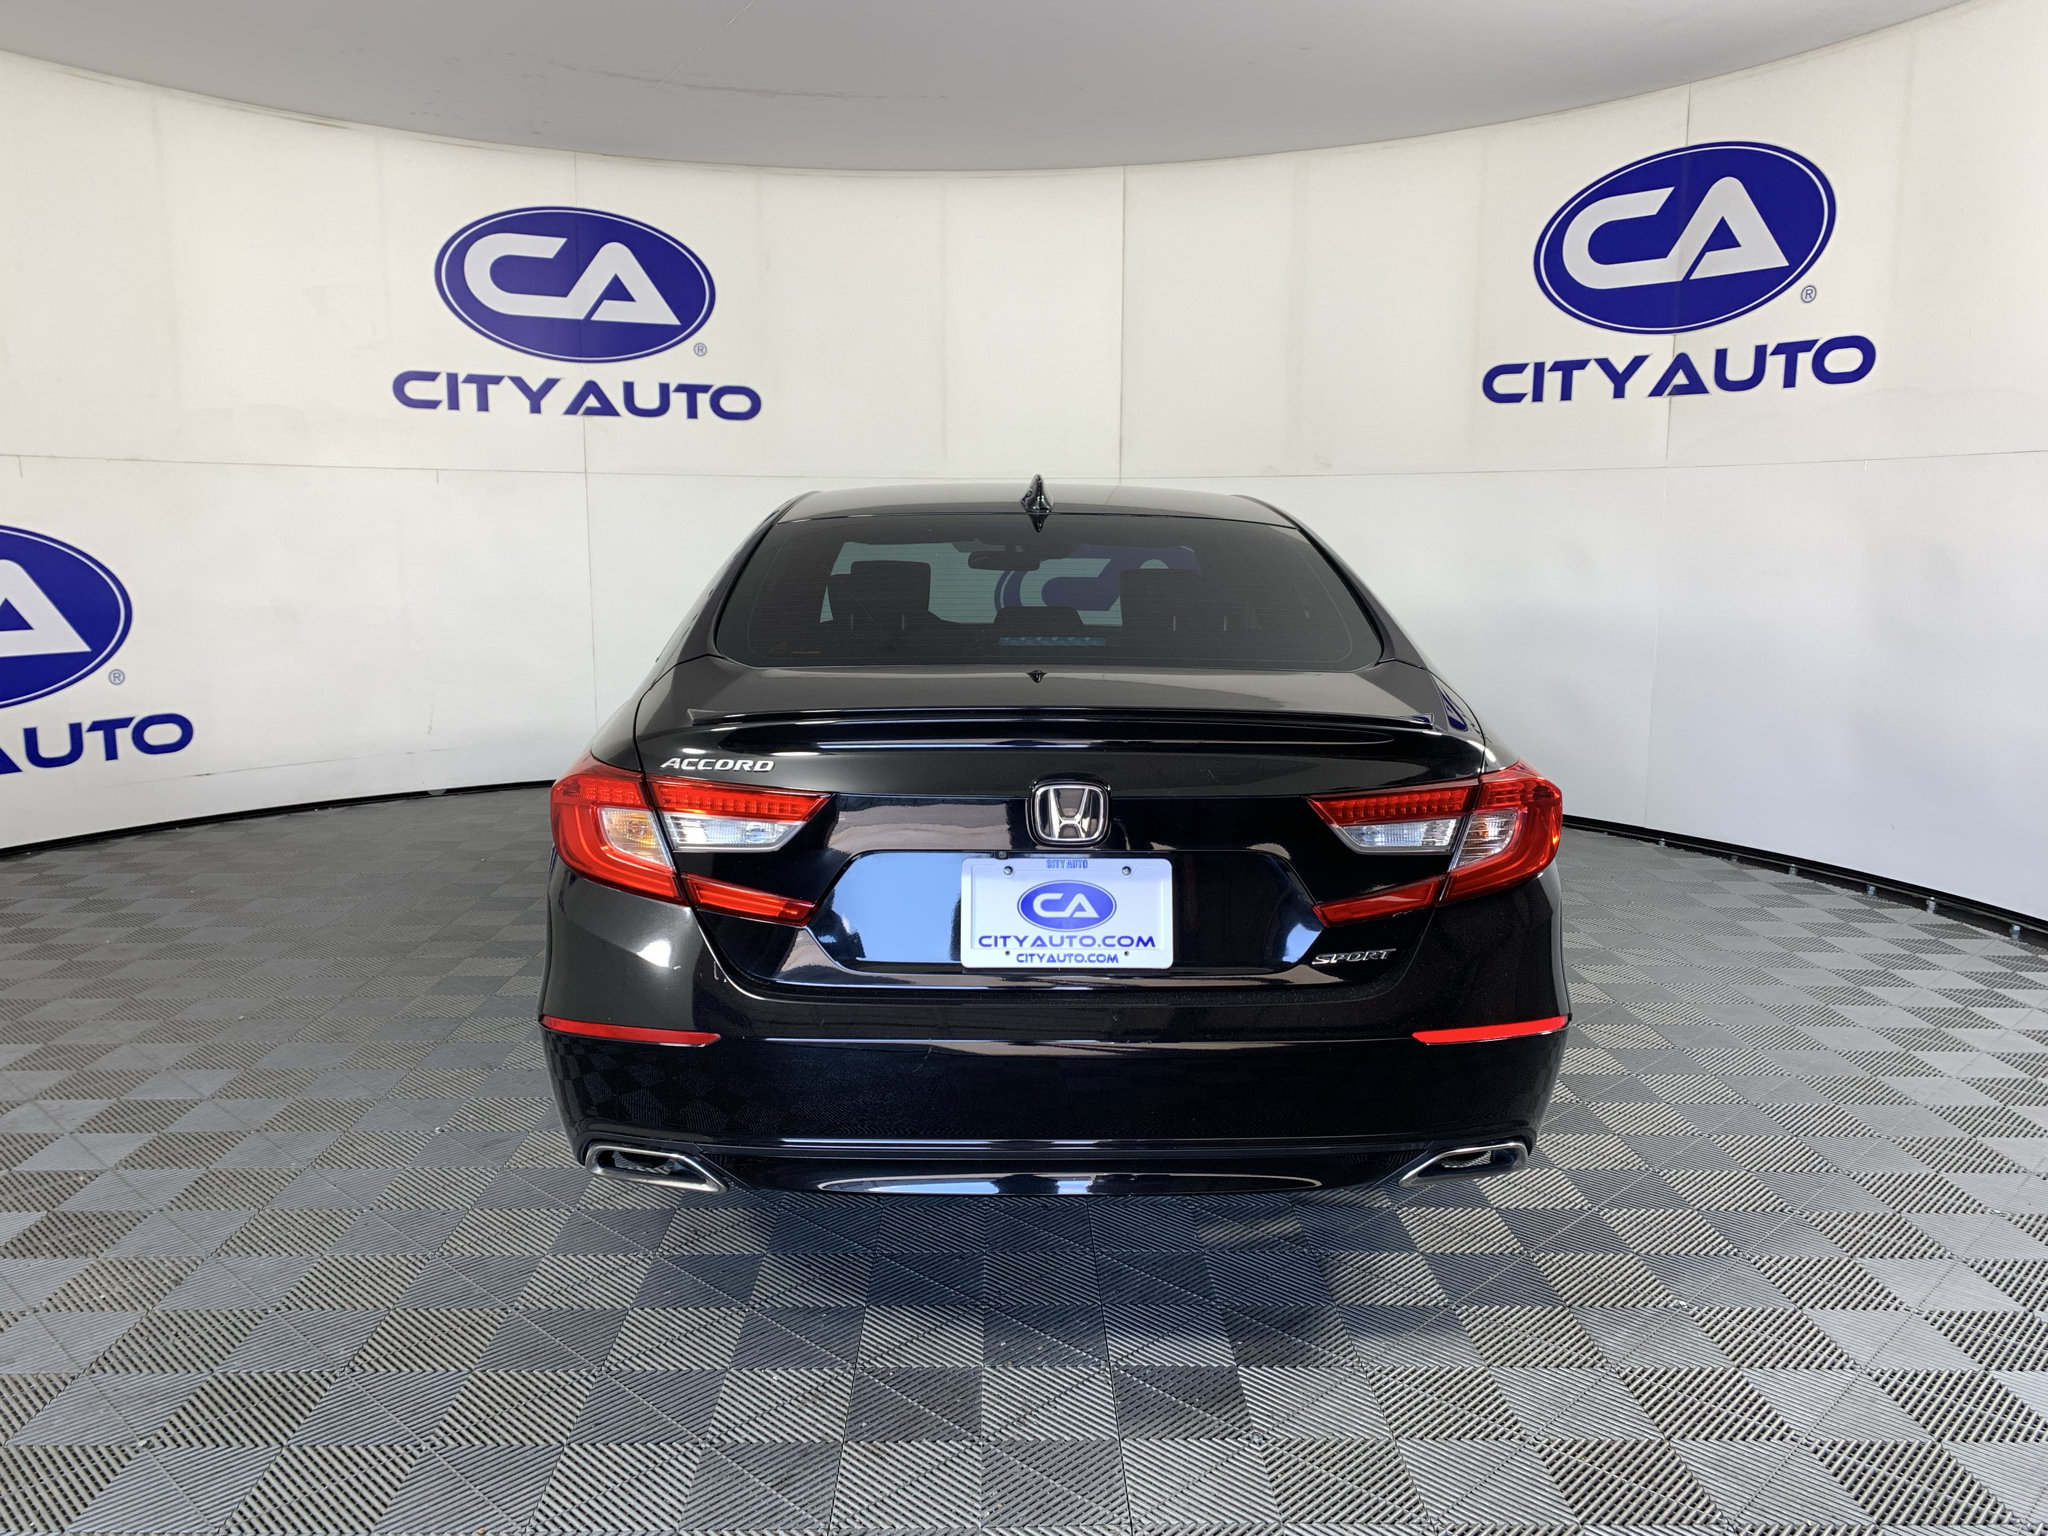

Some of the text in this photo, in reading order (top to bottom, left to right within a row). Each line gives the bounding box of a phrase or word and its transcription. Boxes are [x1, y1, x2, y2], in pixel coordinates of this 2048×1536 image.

[1562, 176, 1790, 290] CA
[464, 232, 682, 326] CA
[0, 559, 92, 658] A
[660, 757, 776, 772] ACCORD
[1046, 858, 1089, 869] CITY AUTO
[1032, 892, 1101, 919] CA
[978, 935, 1156, 948] CITYAUTO.COM
[1016, 952, 1119, 964] CITYAUTO.COM
[1311, 948, 1397, 965] SPORT
